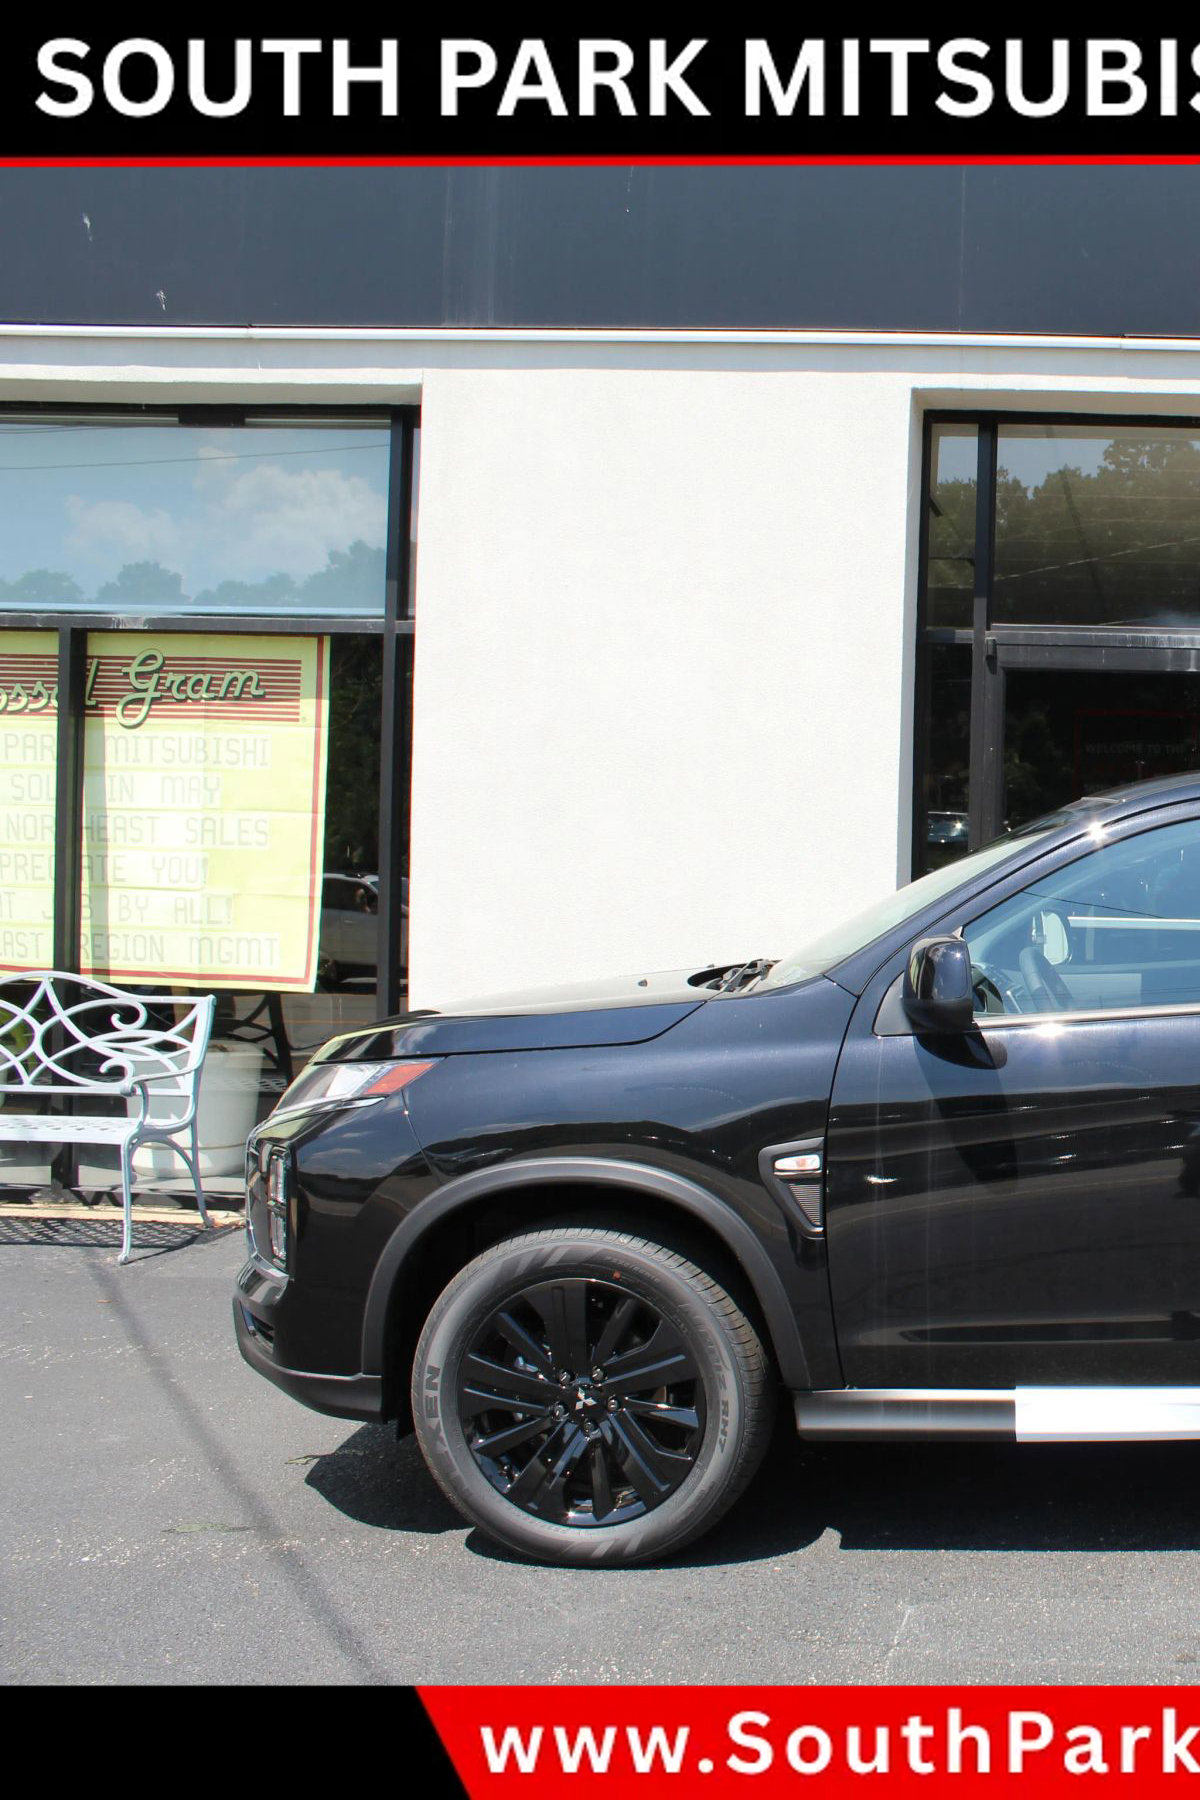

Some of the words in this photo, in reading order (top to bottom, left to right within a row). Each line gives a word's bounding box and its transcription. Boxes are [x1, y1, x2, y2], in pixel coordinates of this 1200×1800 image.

[116, 648, 266, 729] Gram
[4, 732, 57, 762] PAR
[107, 735, 271, 767] MITSUBISHI
[11, 774, 56, 801] SOL
[108, 775, 135, 803] IN
[160, 775, 221, 804] MAY
[6, 813, 161, 845] NORHEAST
[184, 816, 269, 848] SALES
[152, 855, 209, 886] YOU!
[118, 892, 150, 922] BY
[174, 895, 235, 926] ALL!
[80, 932, 165, 964] REGION
[189, 935, 279, 968] MGMT
